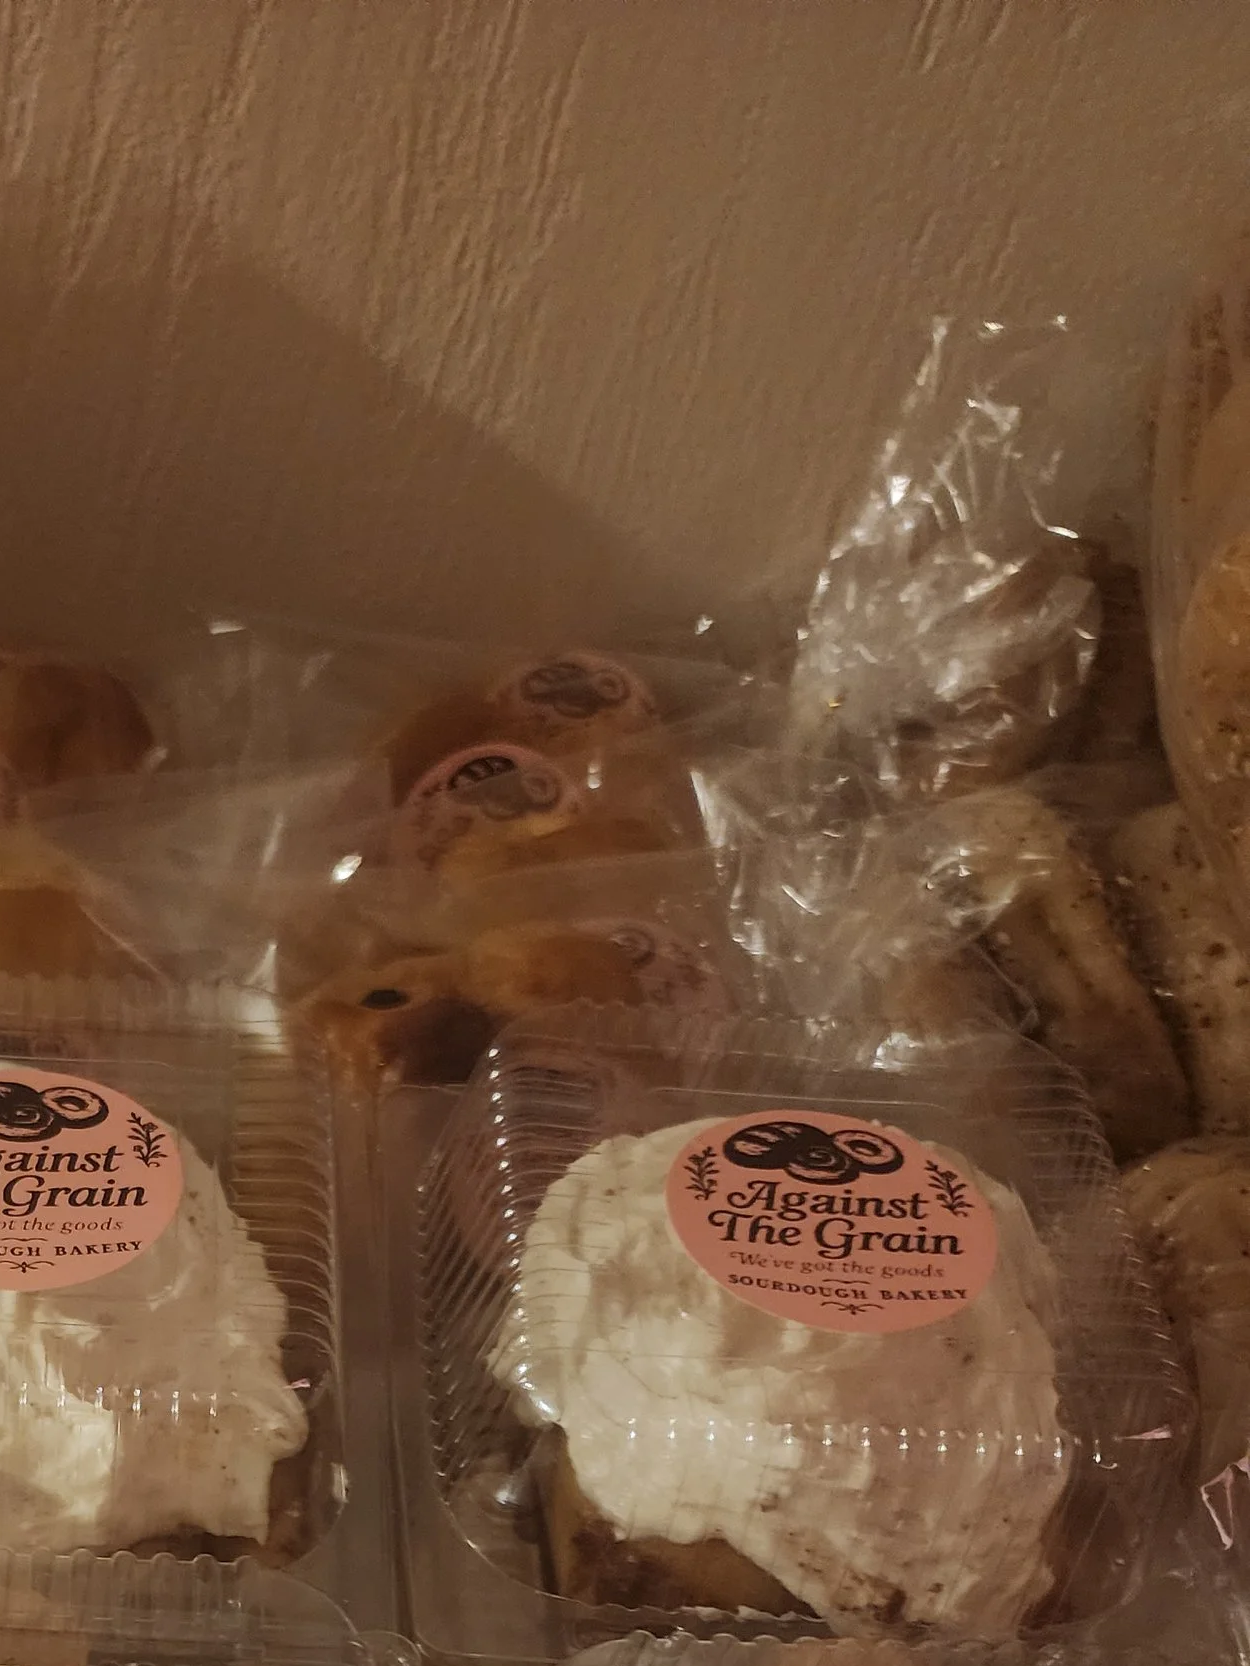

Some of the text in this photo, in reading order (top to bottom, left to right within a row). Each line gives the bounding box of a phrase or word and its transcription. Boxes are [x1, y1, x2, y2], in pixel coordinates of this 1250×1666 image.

[2, 1175, 148, 1217] Grain
[727, 1180, 930, 1221] Against
[23, 1213, 54, 1231] the
[60, 1216, 123, 1234] goods
[708, 1209, 964, 1259] The Grain
[55, 1240, 142, 1256] BAKERY
[730, 1251, 945, 1278] We've got the goods
[728, 1274, 968, 1301] SOURDOUGH BAKERY
